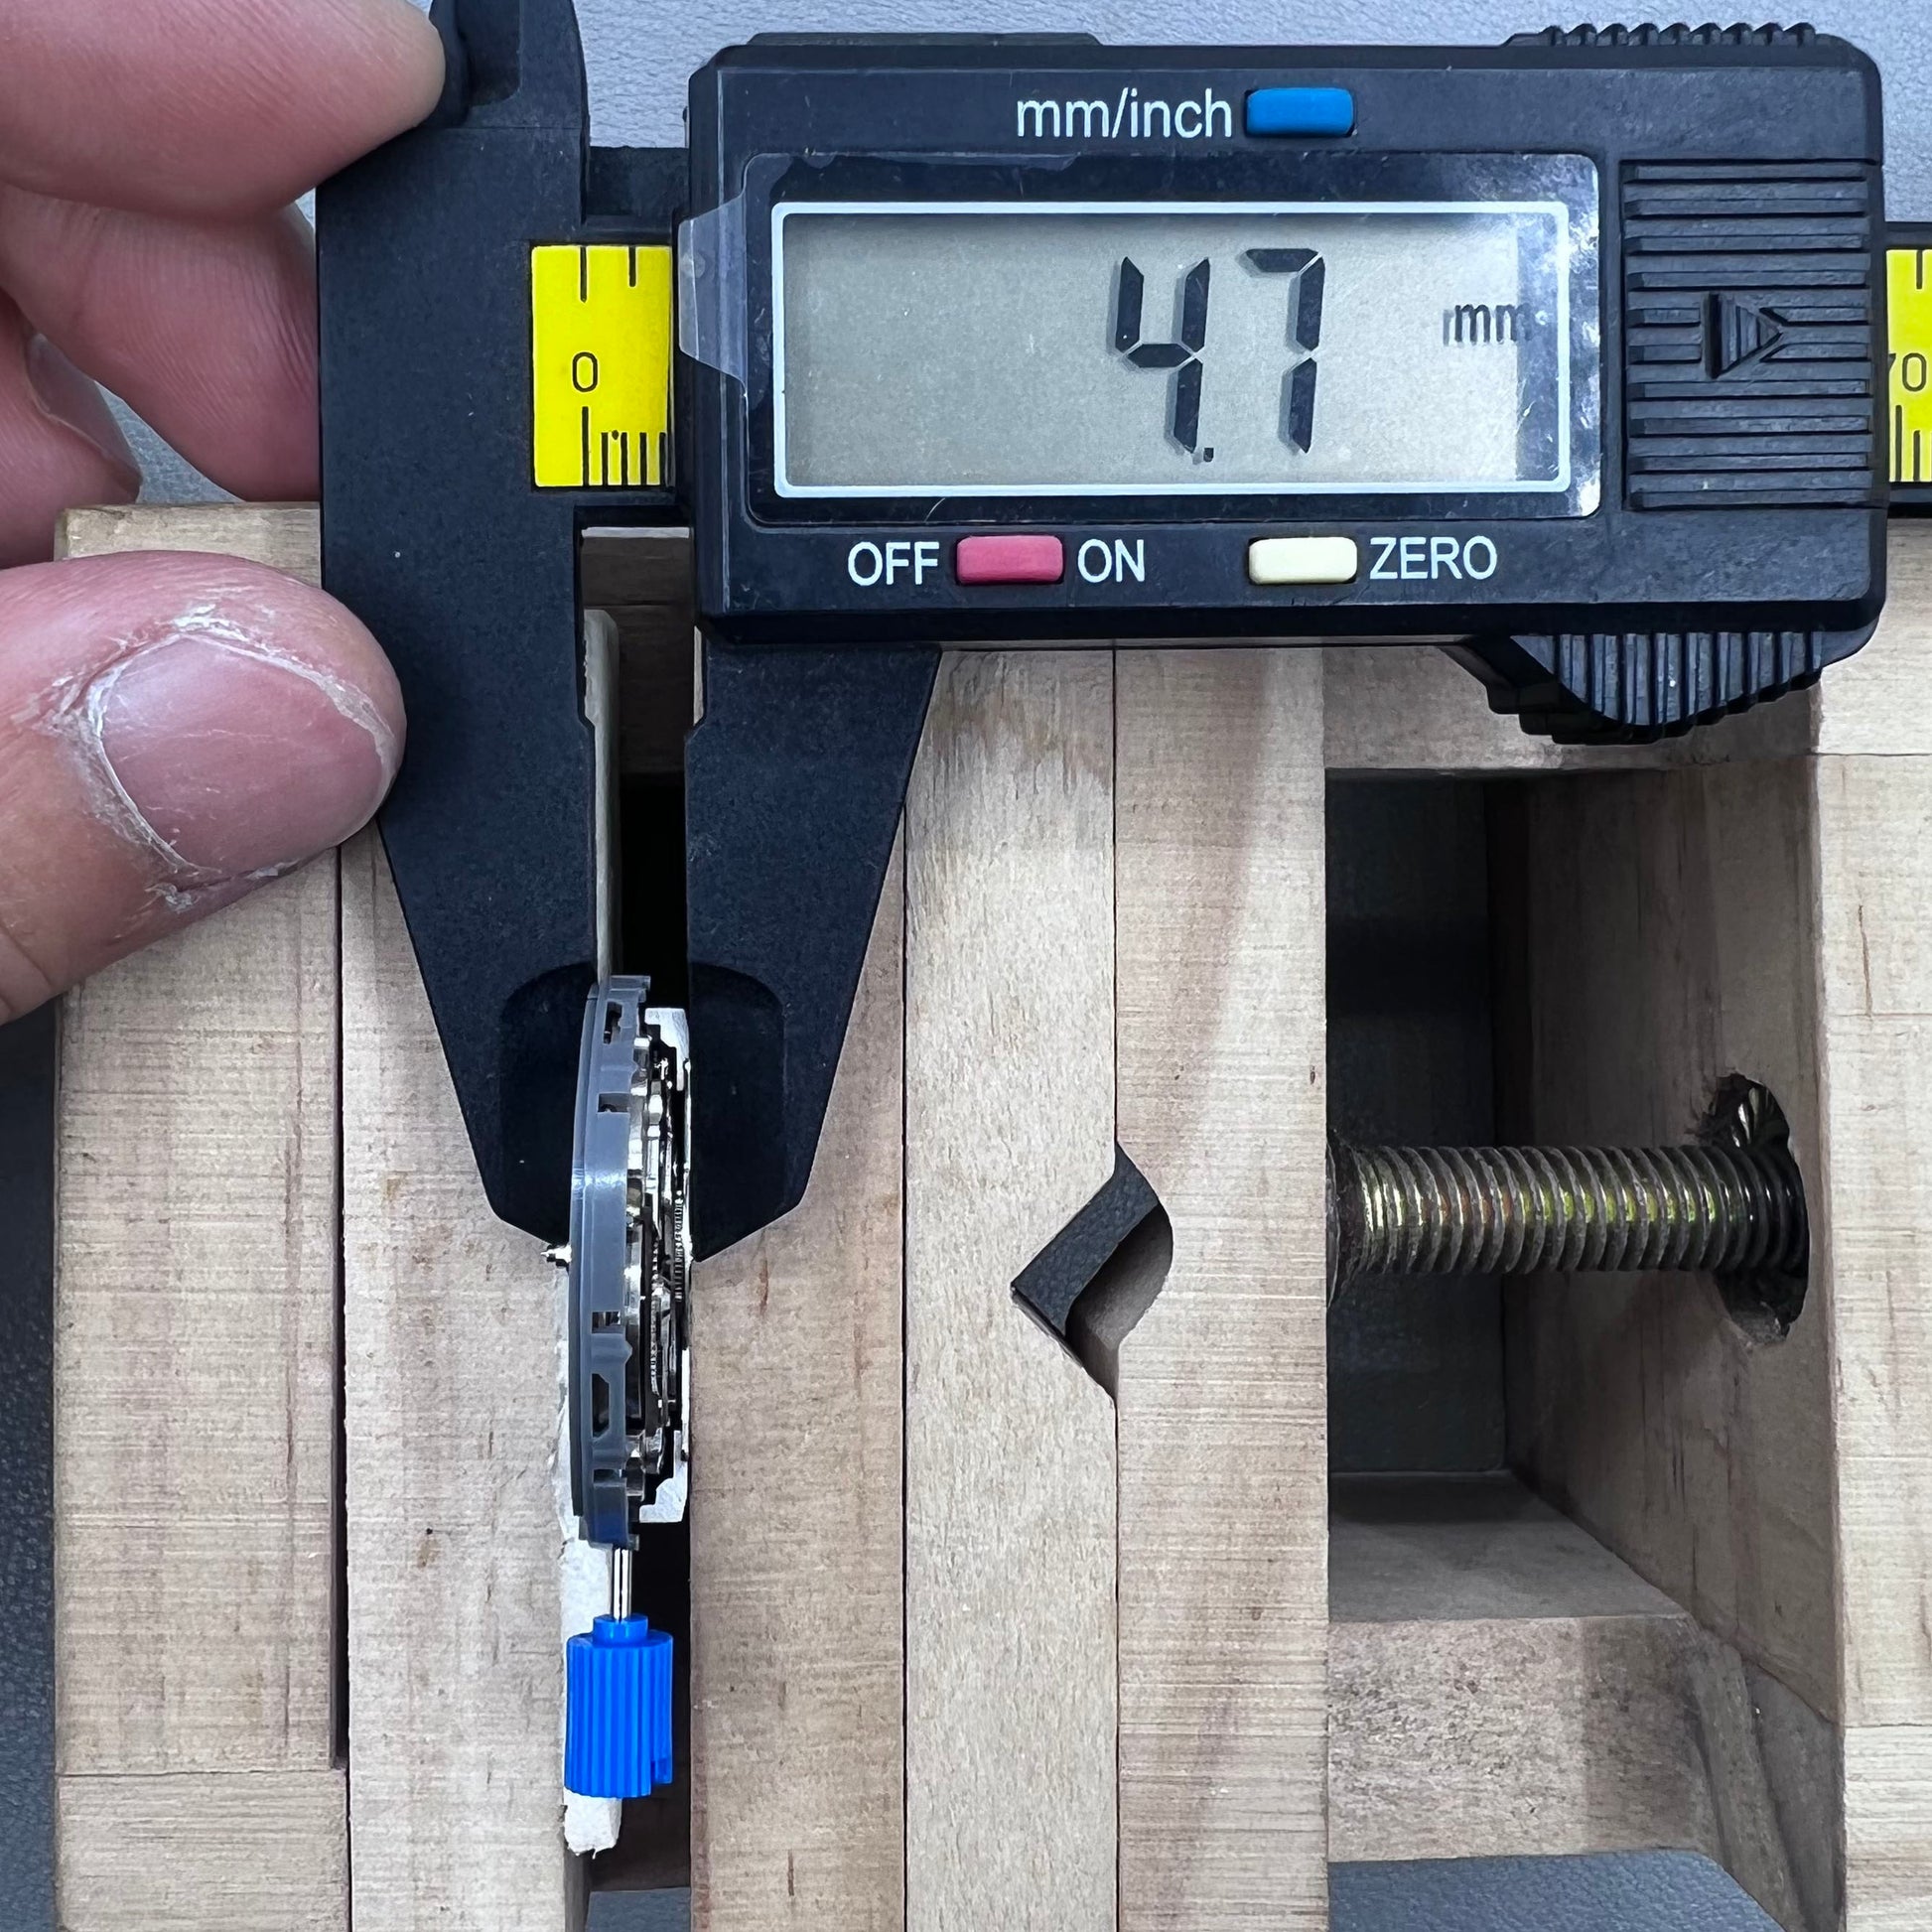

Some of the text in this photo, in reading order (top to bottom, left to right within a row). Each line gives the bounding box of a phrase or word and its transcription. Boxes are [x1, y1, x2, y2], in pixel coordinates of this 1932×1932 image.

[1018, 87, 1231, 138] mm/inch
[572, 351, 599, 393] 0
[1114, 247, 1325, 464] 4.7
[848, 541, 939, 586] OFF
[1077, 539, 1146, 583] ON
[1369, 535, 1498, 580] ZERO
